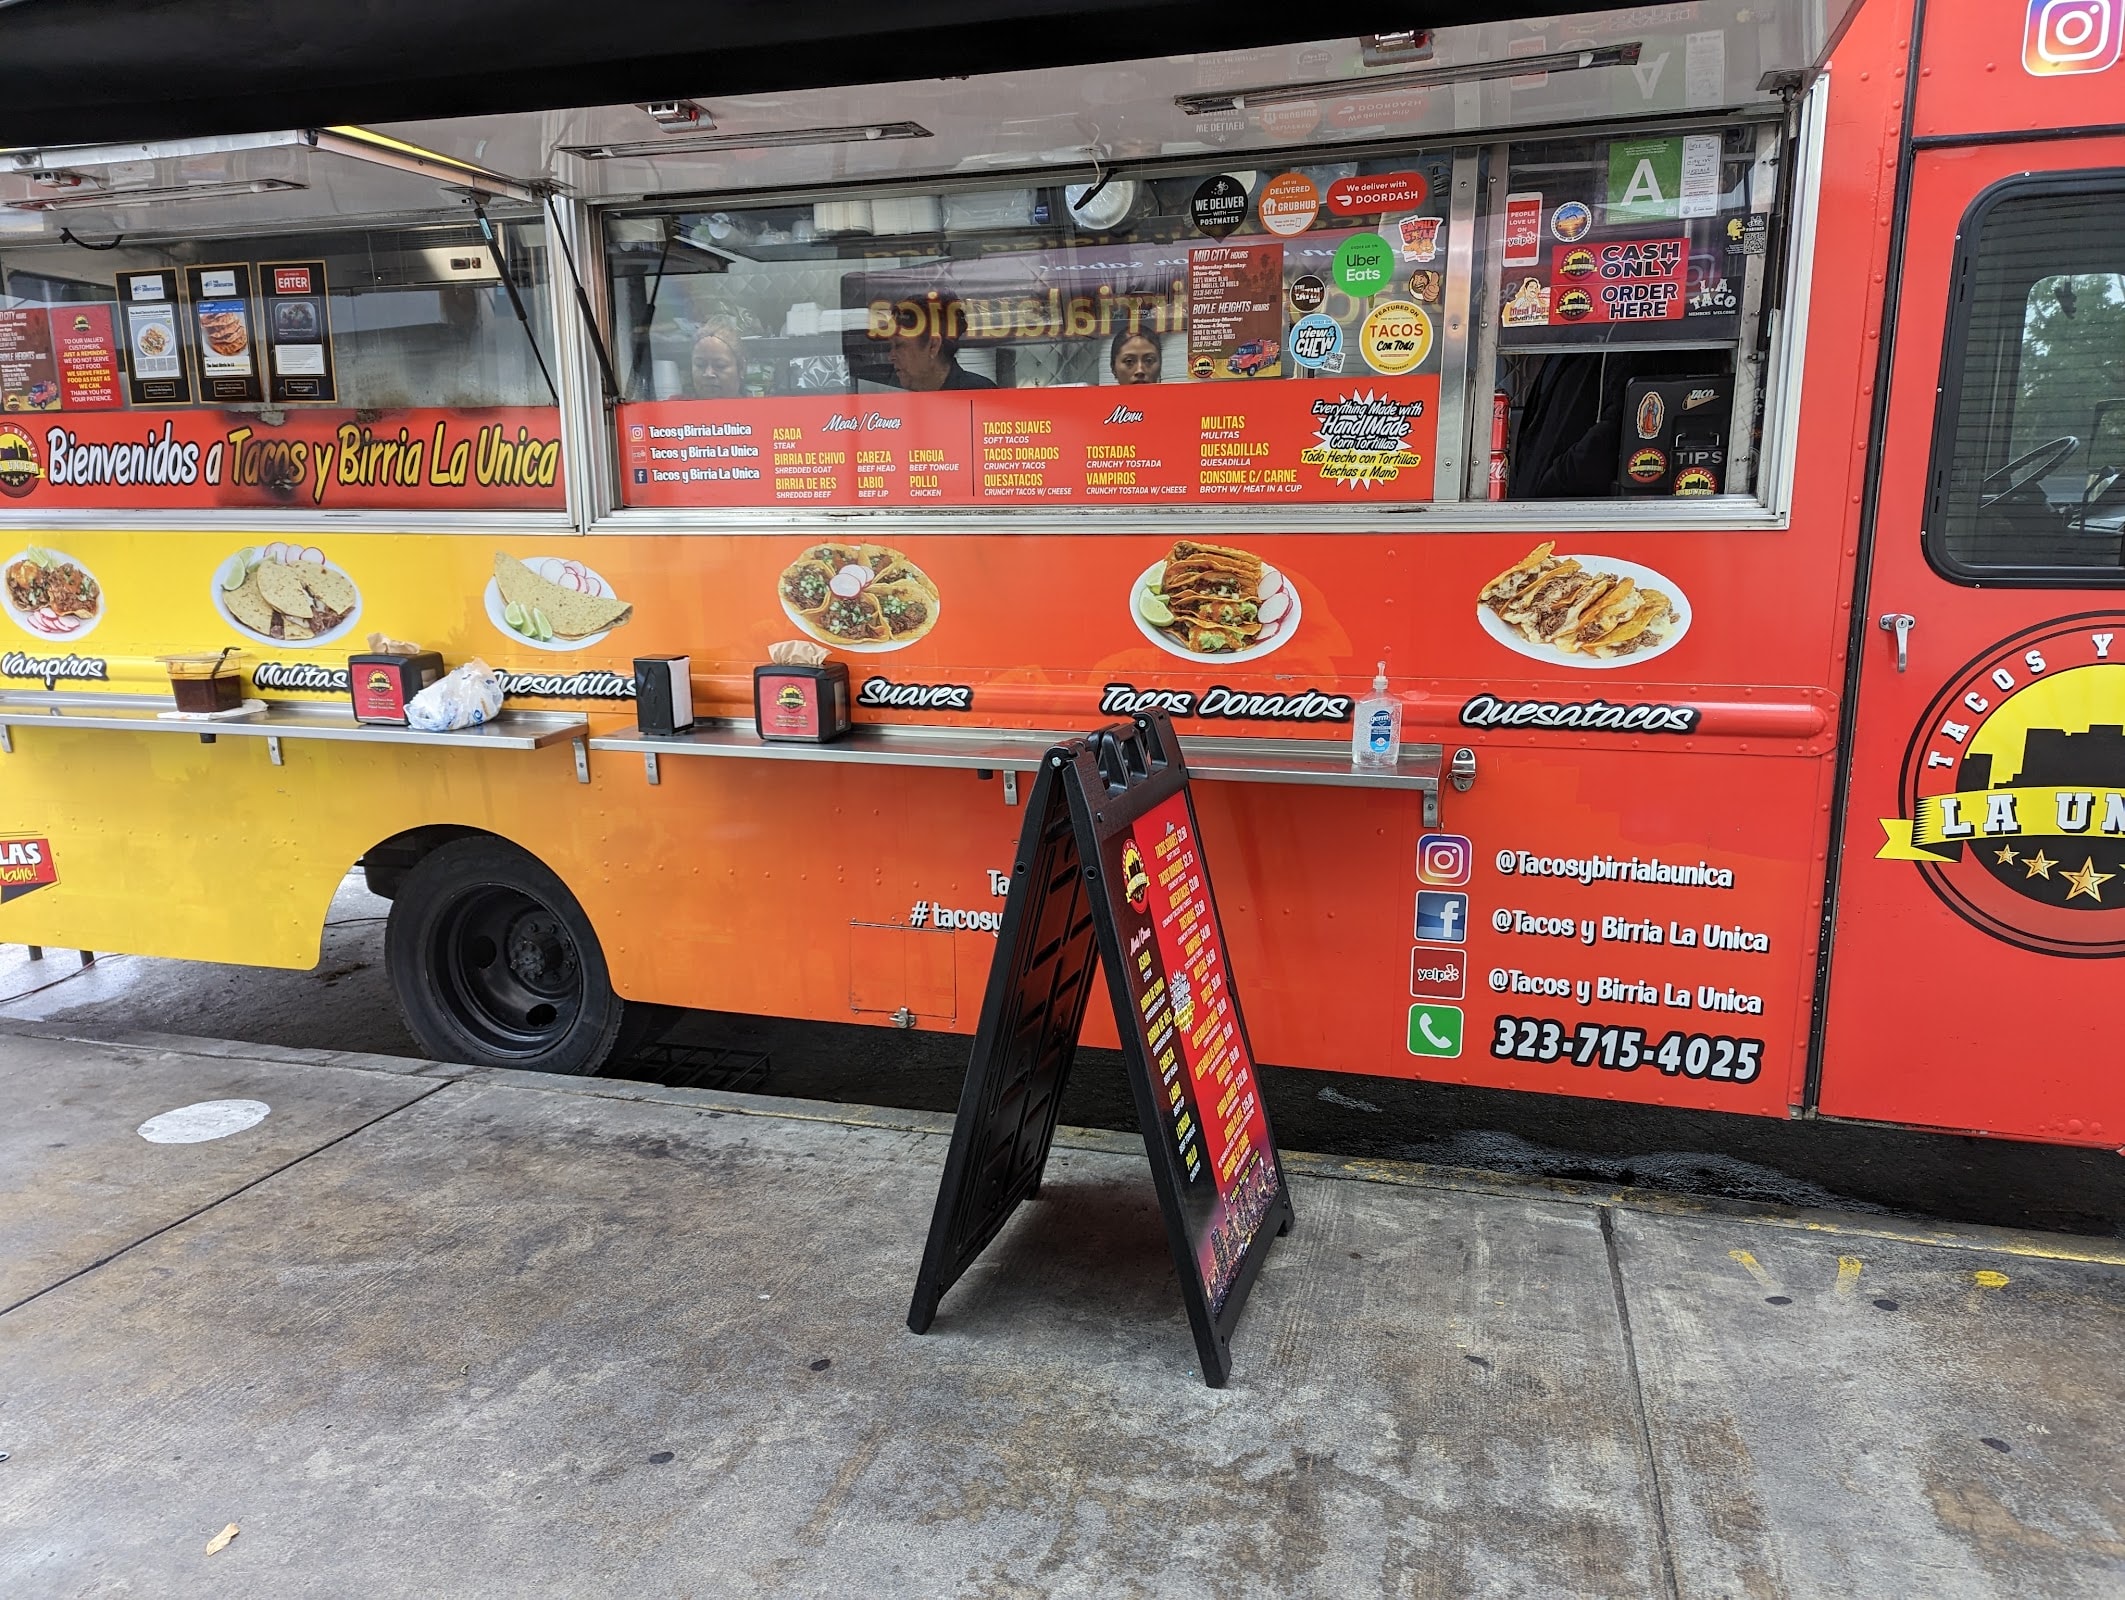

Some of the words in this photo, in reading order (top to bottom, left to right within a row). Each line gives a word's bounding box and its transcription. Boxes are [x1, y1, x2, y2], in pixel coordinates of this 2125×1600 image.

[1361, 182, 1388, 190] deliver
[1390, 180, 1407, 188] with
[1621, 159, 1664, 206] A
[1270, 186, 1310, 195] DELIVERED
[1356, 191, 1418, 203] DOORDASH
[1196, 199, 1208, 211] WE
[1210, 196, 1244, 210] DELIVER
[1278, 200, 1316, 212] GRUBHUB
[1200, 216, 1239, 226] POSTMATES
[1508, 235, 1526, 247] yelp
[1193, 250, 1209, 262] MID
[1211, 249, 1230, 261] CITY
[1230, 251, 1248, 259] HOURS
[1601, 242, 1680, 262] CASH
[1347, 254, 1380, 267] Uber
[1346, 268, 1380, 282] Eats
[1600, 258, 1681, 279] ONLY
[278, 277, 307, 288] EATER
[1700, 279, 1732, 293] L.A.
[1601, 282, 1678, 303] ORDER
[1193, 303, 1217, 314] BOYLE
[1218, 301, 1252, 314] HEIGHTS
[1689, 293, 1736, 310] TACO
[1375, 305, 1409, 318] FEATURED
[1410, 309, 1419, 317] ON
[1609, 300, 1668, 319] HERE
[1370, 324, 1424, 337] TACOS
[1296, 338, 1335, 357] CHEW
[1377, 341, 1393, 351] Con
[1691, 389, 1715, 400] TACO
[1104, 405, 1143, 424] Menu
[1312, 400, 1367, 418] Everything
[1368, 401, 1398, 416] Made
[1398, 400, 1423, 416] with
[822, 414, 858, 432] Meats
[868, 412, 902, 431] Carnes
[983, 421, 1012, 435] TACOS
[1015, 420, 1052, 434] SUAVES
[1201, 416, 1245, 430] MULITAS
[773, 428, 802, 440] ASADA
[983, 436, 1003, 444] SOFT
[1005, 436, 1029, 444] TACOS
[1201, 431, 1240, 439] MULITAS
[1201, 443, 1269, 457] QUESADILLAS
[1331, 436, 1354, 449] Corn
[1355, 437, 1398, 450] Tortillas
[774, 452, 802, 465] BIRRIA
[805, 452, 816, 465] DE
[818, 452, 846, 464] CHIVO
[856, 451, 892, 464] CABEZA
[909, 450, 944, 462] LENGUA
[984, 448, 1013, 461] TACOS
[1016, 447, 1059, 460] DORADOS
[1086, 445, 1136, 459] TOSTADAS
[1303, 450, 1325, 462] Todo
[1326, 450, 1357, 463] Hecho
[1359, 455, 1376, 463] con
[1380, 452, 1419, 465] Tortillas
[1676, 451, 1723, 465] TIPS
[46, 420, 199, 486] Bienvenidos
[204, 440, 223, 486] a
[227, 425, 309, 486] Tacos
[313, 442, 335, 504] y
[337, 422, 424, 486] Birria
[429, 420, 470, 486] La
[474, 424, 560, 487] Unica
[984, 462, 1019, 470] CRUNCHY
[1086, 461, 1123, 469] CRUNCHY
[1126, 460, 1161, 468] TOSTADA
[1200, 458, 1251, 466] QUESADILLA
[775, 466, 812, 474] SHREDDED
[1200, 470, 1246, 484] CONSOME
[1249, 470, 1262, 484] C/
[1264, 469, 1297, 482] CARNE
[1322, 464, 1358, 477] Hechas
[1369, 466, 1397, 478] Mano
[776, 478, 804, 490] BIRRIA
[807, 478, 818, 489] DE
[820, 477, 837, 489] RES
[858, 476, 884, 488] LABIO
[909, 475, 938, 488] POLLO
[984, 473, 1043, 487] QUESATACOS
[1086, 472, 1136, 485] VAMPIROS
[858, 490, 876, 498] BEEF
[984, 488, 1015, 496] CRUNCHY
[1037, 487, 1046, 495] W/
[1048, 487, 1072, 495] CHEESE
[1086, 487, 1116, 495] CRUNCHY
[1118, 486, 1148, 494] TOSTADA
[1150, 486, 1160, 494] W/
[1161, 486, 1187, 494] CHEESE
[1, 652, 105, 687] Vampiros
[254, 662, 348, 689] Mulitas
[859, 678, 968, 707] Suaves
[1101, 686, 1190, 714] Tacos
[1198, 690, 1348, 719] Dorados
[1928, 650, 2047, 769] TACOS
[2092, 633, 2114, 658] Y
[1462, 696, 1693, 730] Quesatacos
[1940, 793, 2022, 836] LA
[1496, 850, 1734, 888] @Tacosybirrialaunica
[1492, 908, 1575, 937] @Tacos
[1580, 919, 1595, 944] y
[1602, 916, 1663, 944] Birria
[1669, 922, 1696, 947] La
[1703, 924, 1769, 951] Unica
[1418, 966, 1446, 983] yelp
[1488, 968, 1570, 997] @Tacos
[1576, 979, 1591, 1004] y
[1596, 976, 1658, 1004] Birria
[1664, 983, 1691, 1008] La
[1697, 986, 1763, 1014] Unica
[1495, 1018, 1759, 1080] 323-715-4025
